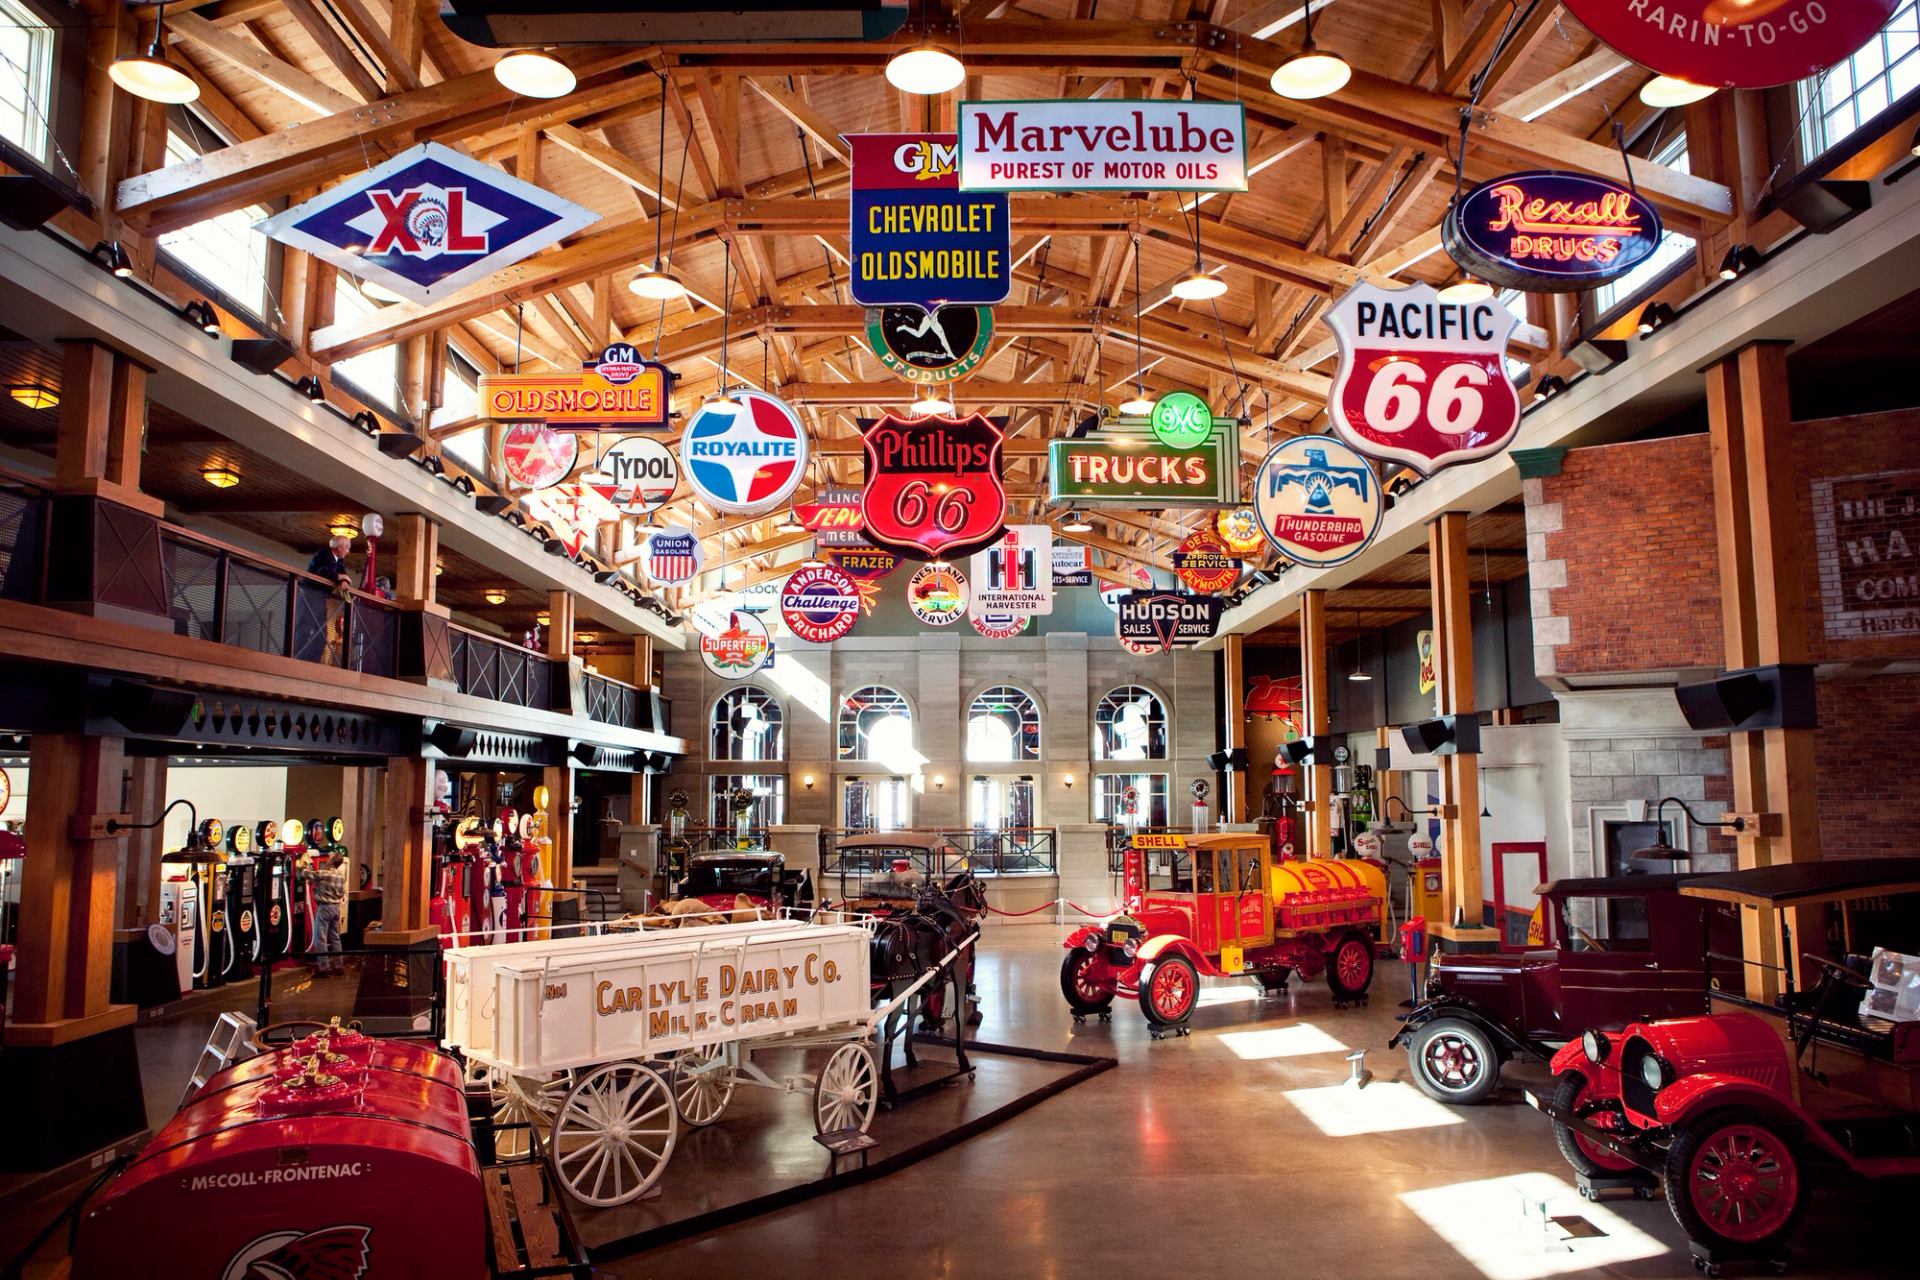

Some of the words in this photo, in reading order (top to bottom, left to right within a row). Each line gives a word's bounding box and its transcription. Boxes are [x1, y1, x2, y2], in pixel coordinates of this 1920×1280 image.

[974, 111, 1235, 153] Marvelube
[990, 163, 1065, 180] PUREST
[1072, 163, 1094, 179] OF
[1104, 163, 1166, 179] MOTOR
[1175, 163, 1218, 180] OILS
[869, 204, 996, 234] CHEVROLET
[1490, 184, 1641, 235] Rexall
[371, 190, 486, 252] XL
[1511, 235, 1621, 262] DRUGS
[861, 250, 999, 280] OLDSMOBILE
[1358, 302, 1494, 341] PACIFIC
[605, 348, 634, 363] GM
[882, 352, 980, 381] PRODUCTS
[493, 389, 651, 413] OLDSMOBILE
[1364, 361, 1490, 435] 66
[692, 441, 796, 457] ROYALITE
[876, 429, 988, 478] Phillips
[608, 452, 674, 485] TYDOL
[1068, 455, 1207, 485] TRUCKS
[829, 493, 862, 503] LINC
[894, 480, 976, 536] 66
[806, 508, 864, 526] SERV
[1279, 516, 1362, 533] THUNDERBIRD
[656, 539, 690, 548] UNION
[1294, 532, 1345, 543] GASOLINE
[842, 556, 894, 569] FRAZER
[1181, 560, 1235, 568] SERVICE
[790, 568, 855, 596] ANDERSON
[912, 566, 965, 585] WESTLAND
[1065, 576, 1088, 584] SERVICE
[1183, 569, 1234, 591] PLYMOUTH
[784, 595, 857, 612] Challenge
[978, 594, 1046, 602] INTERNATIONAL
[915, 608, 962, 624] SERVICE
[1122, 604, 1210, 620] HUDSON
[788, 613, 853, 639] PRICHARD
[972, 616, 1026, 638] PRODUCTS
[1123, 624, 1152, 634] SALES
[1178, 624, 1210, 634] SERVICE
[705, 639, 765, 652] SUPERTEST
[1136, 837, 1179, 847] SHELL
[597, 976, 709, 1016] CARLYLE
[719, 964, 799, 999] DAIRY
[649, 998, 798, 1040] MILK-CREAM
[191, 1162, 362, 1191] McCOLL-FRONTENAC
